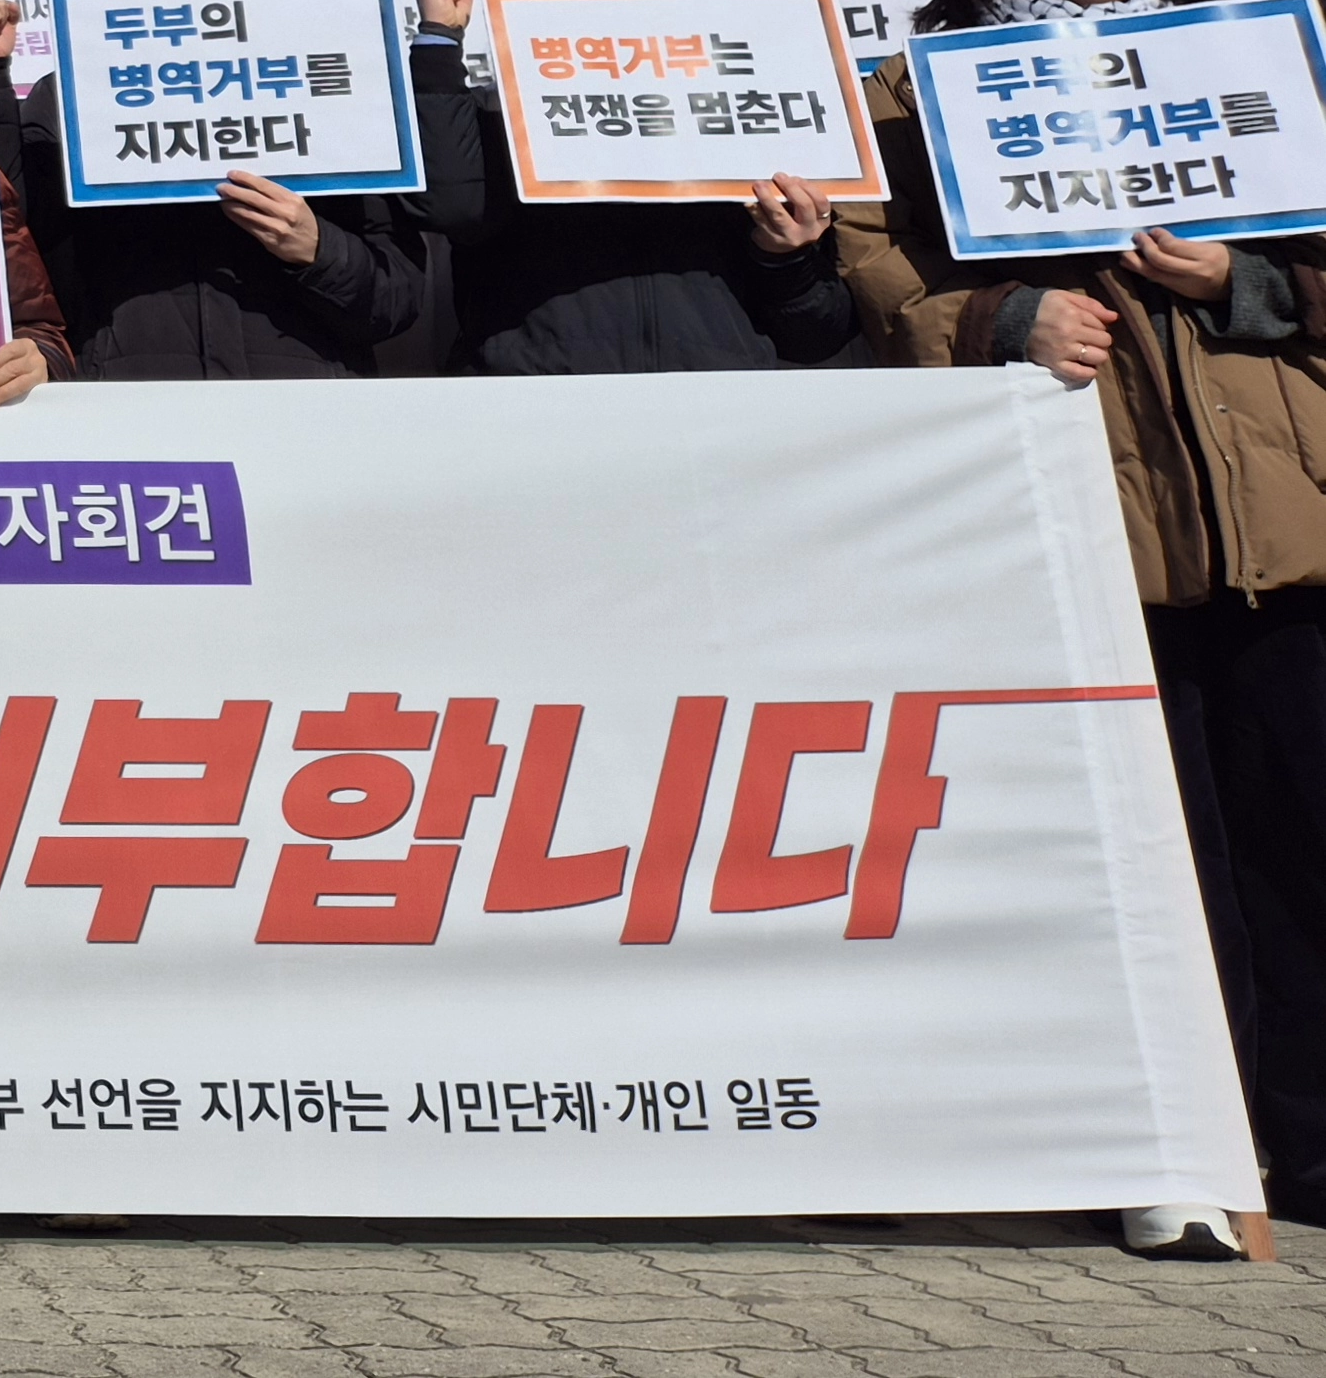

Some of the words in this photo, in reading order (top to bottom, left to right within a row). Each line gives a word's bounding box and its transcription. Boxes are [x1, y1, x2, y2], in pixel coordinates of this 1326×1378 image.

[103, 1, 247, 52] 두부의
[108, 52, 353, 109] 병역거부를
[530, 33, 755, 81] 병역거부는
[976, 49, 1146, 102] 두부의
[115, 113, 312, 164] 지지한다
[542, 92, 676, 139] 전쟁을
[688, 89, 827, 137] 멈춘다
[986, 90, 1280, 159] 병역거부를
[999, 155, 1236, 214] 지지한다
[41, 1077, 182, 1132] 선언을
[200, 1078, 389, 1134] 지지하는
[407, 1079, 709, 1135] 시민단체·개인
[727, 1077, 821, 1132] 일동
